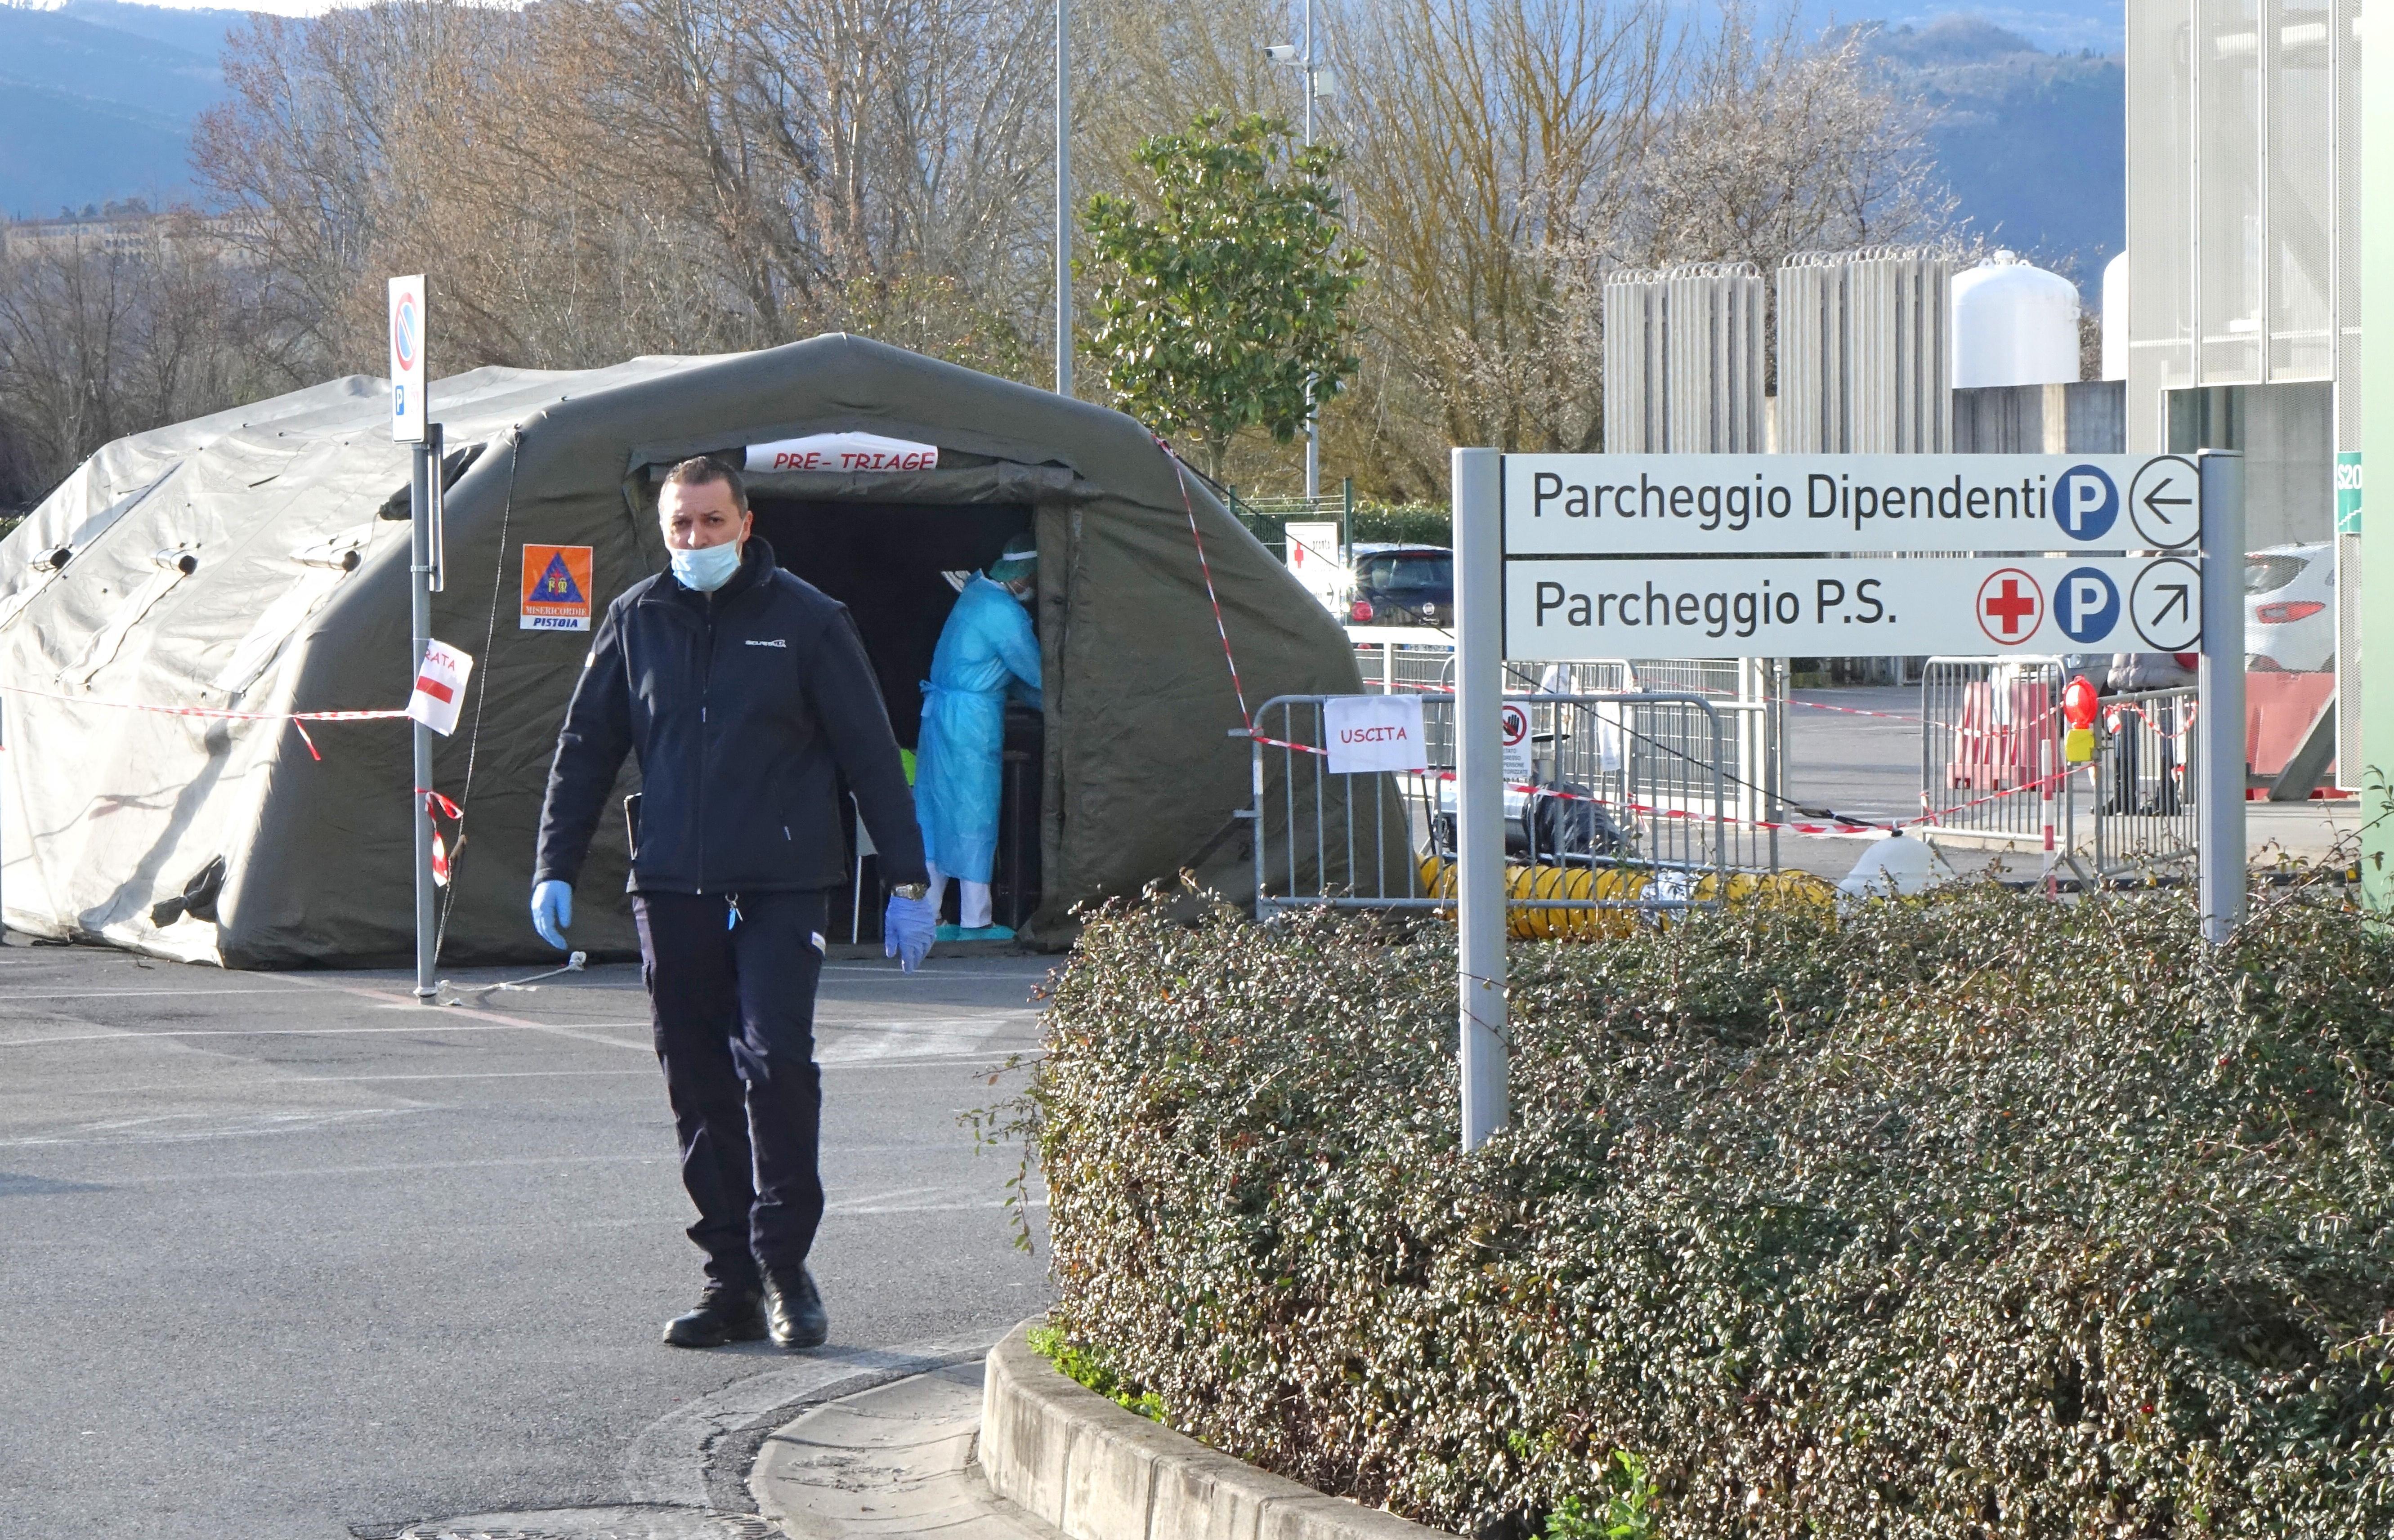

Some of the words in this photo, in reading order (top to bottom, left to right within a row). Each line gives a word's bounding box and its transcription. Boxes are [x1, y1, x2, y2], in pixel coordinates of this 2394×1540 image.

[396, 388, 403, 412] P
[774, 452, 832, 470] PRE-
[840, 452, 936, 470] TRIAGE
[1535, 473, 1791, 531] Parcheggio
[1808, 473, 2046, 531] Dipendenti
[2069, 475, 2107, 530] P
[525, 606, 586, 616] MISERICORDIE
[1537, 580, 1800, 638] Parcheggio
[1817, 579, 1896, 624] P.S.
[2071, 578, 2108, 633] P
[533, 617, 578, 628] PISTOIA
[1340, 727, 1408, 743] USCITA
